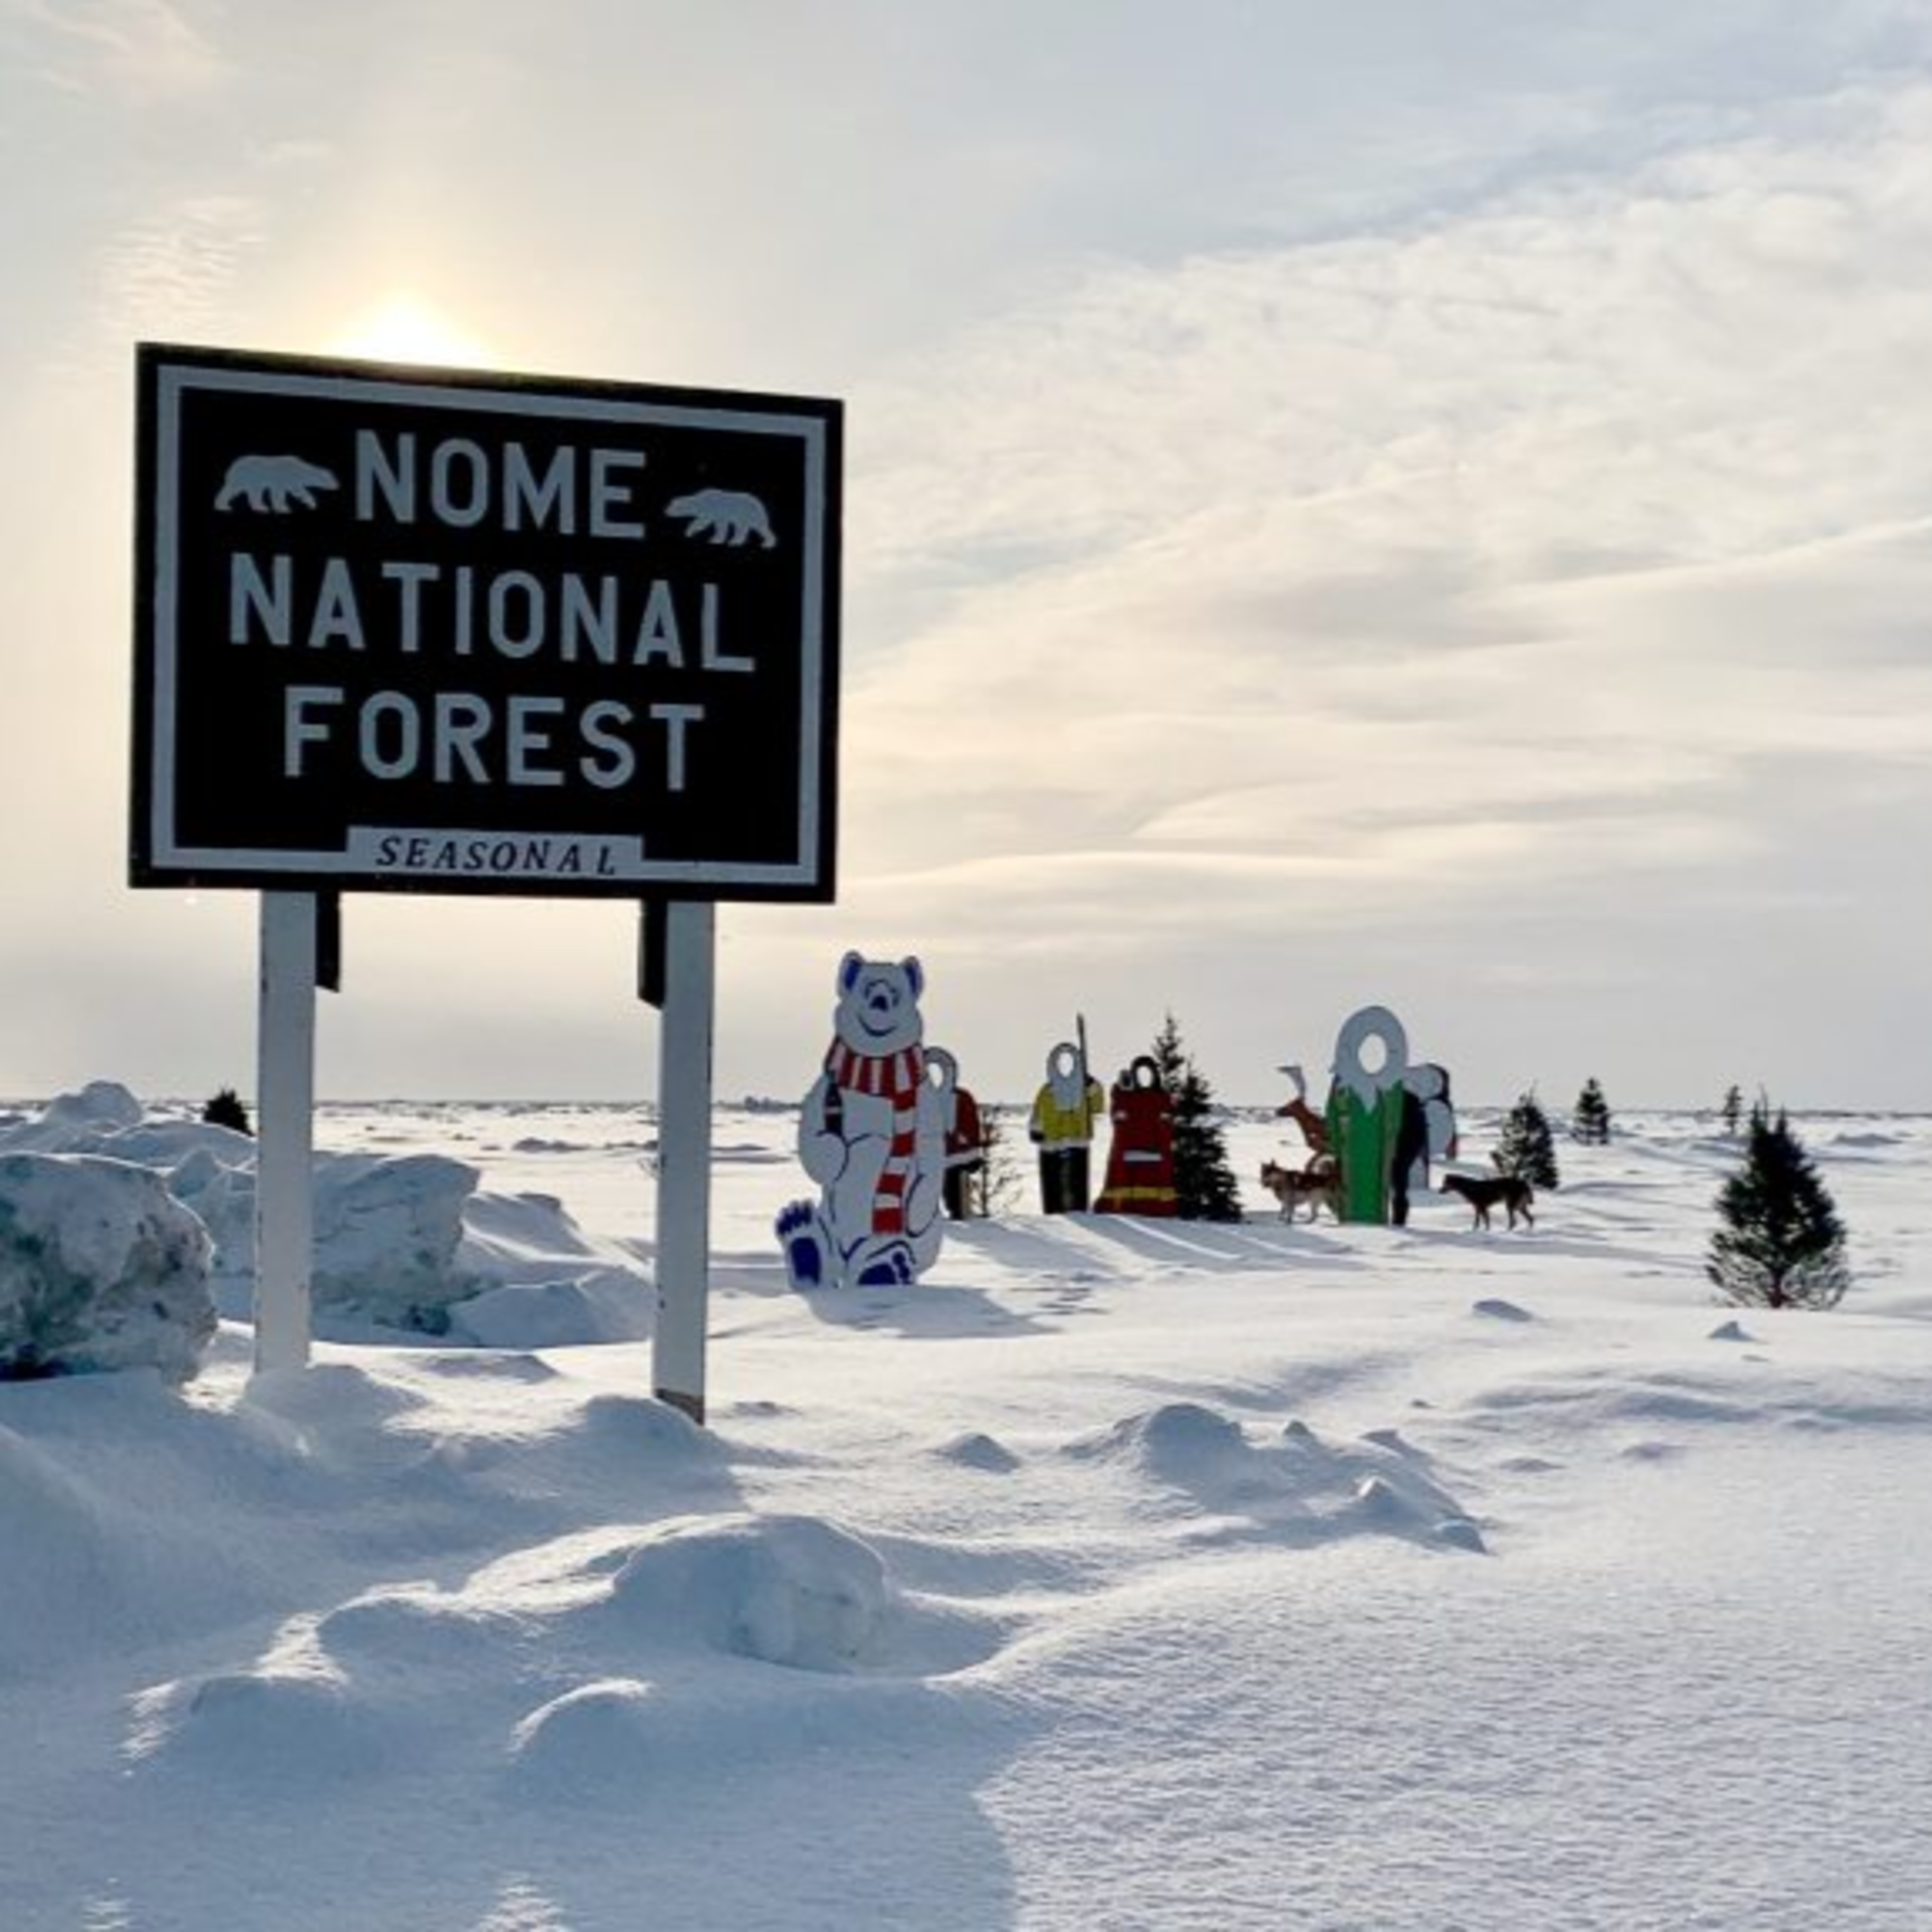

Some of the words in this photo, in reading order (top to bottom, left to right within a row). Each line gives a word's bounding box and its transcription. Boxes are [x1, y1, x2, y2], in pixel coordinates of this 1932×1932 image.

[356, 428, 646, 540] NOME
[230, 552, 756, 673] NATIONAL
[284, 685, 705, 792] FOREST
[376, 835, 617, 877] SEASONAL
